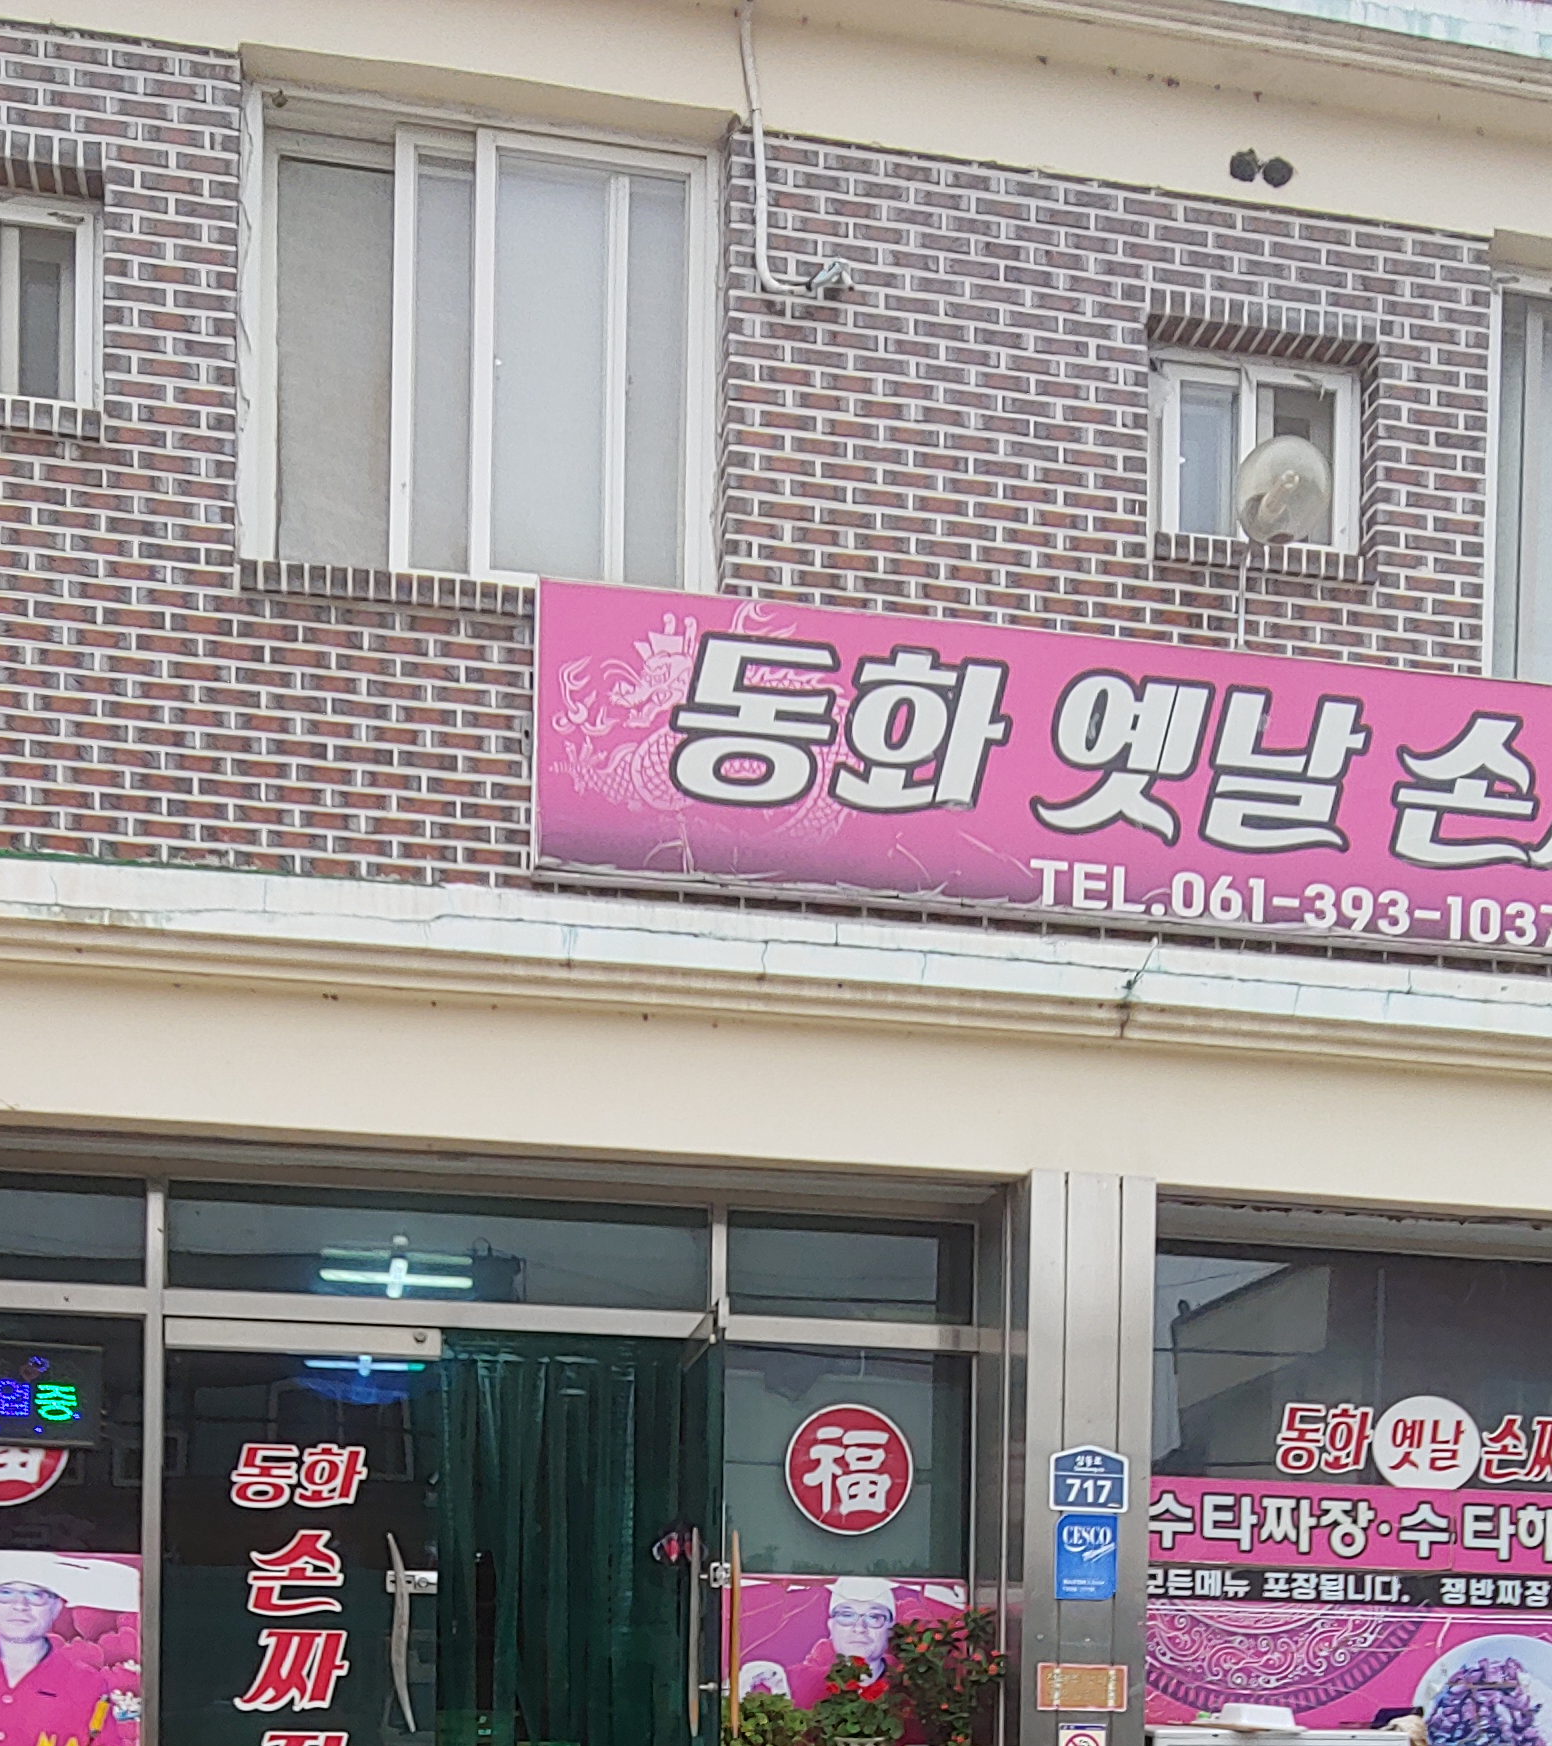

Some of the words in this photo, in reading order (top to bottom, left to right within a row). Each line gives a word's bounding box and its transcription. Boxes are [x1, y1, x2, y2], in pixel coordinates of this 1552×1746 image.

[673, 633, 1011, 812] 동화
[1032, 668, 1371, 854] 옛날
[802, 1424, 893, 1517] 福
[1276, 1402, 1373, 1475] 동화
[1388, 1416, 1466, 1471] 옛날
[230, 1444, 367, 1508] 동화
[1066, 1480, 1112, 1503] 717
[1062, 1525, 1112, 1547] CESCO
